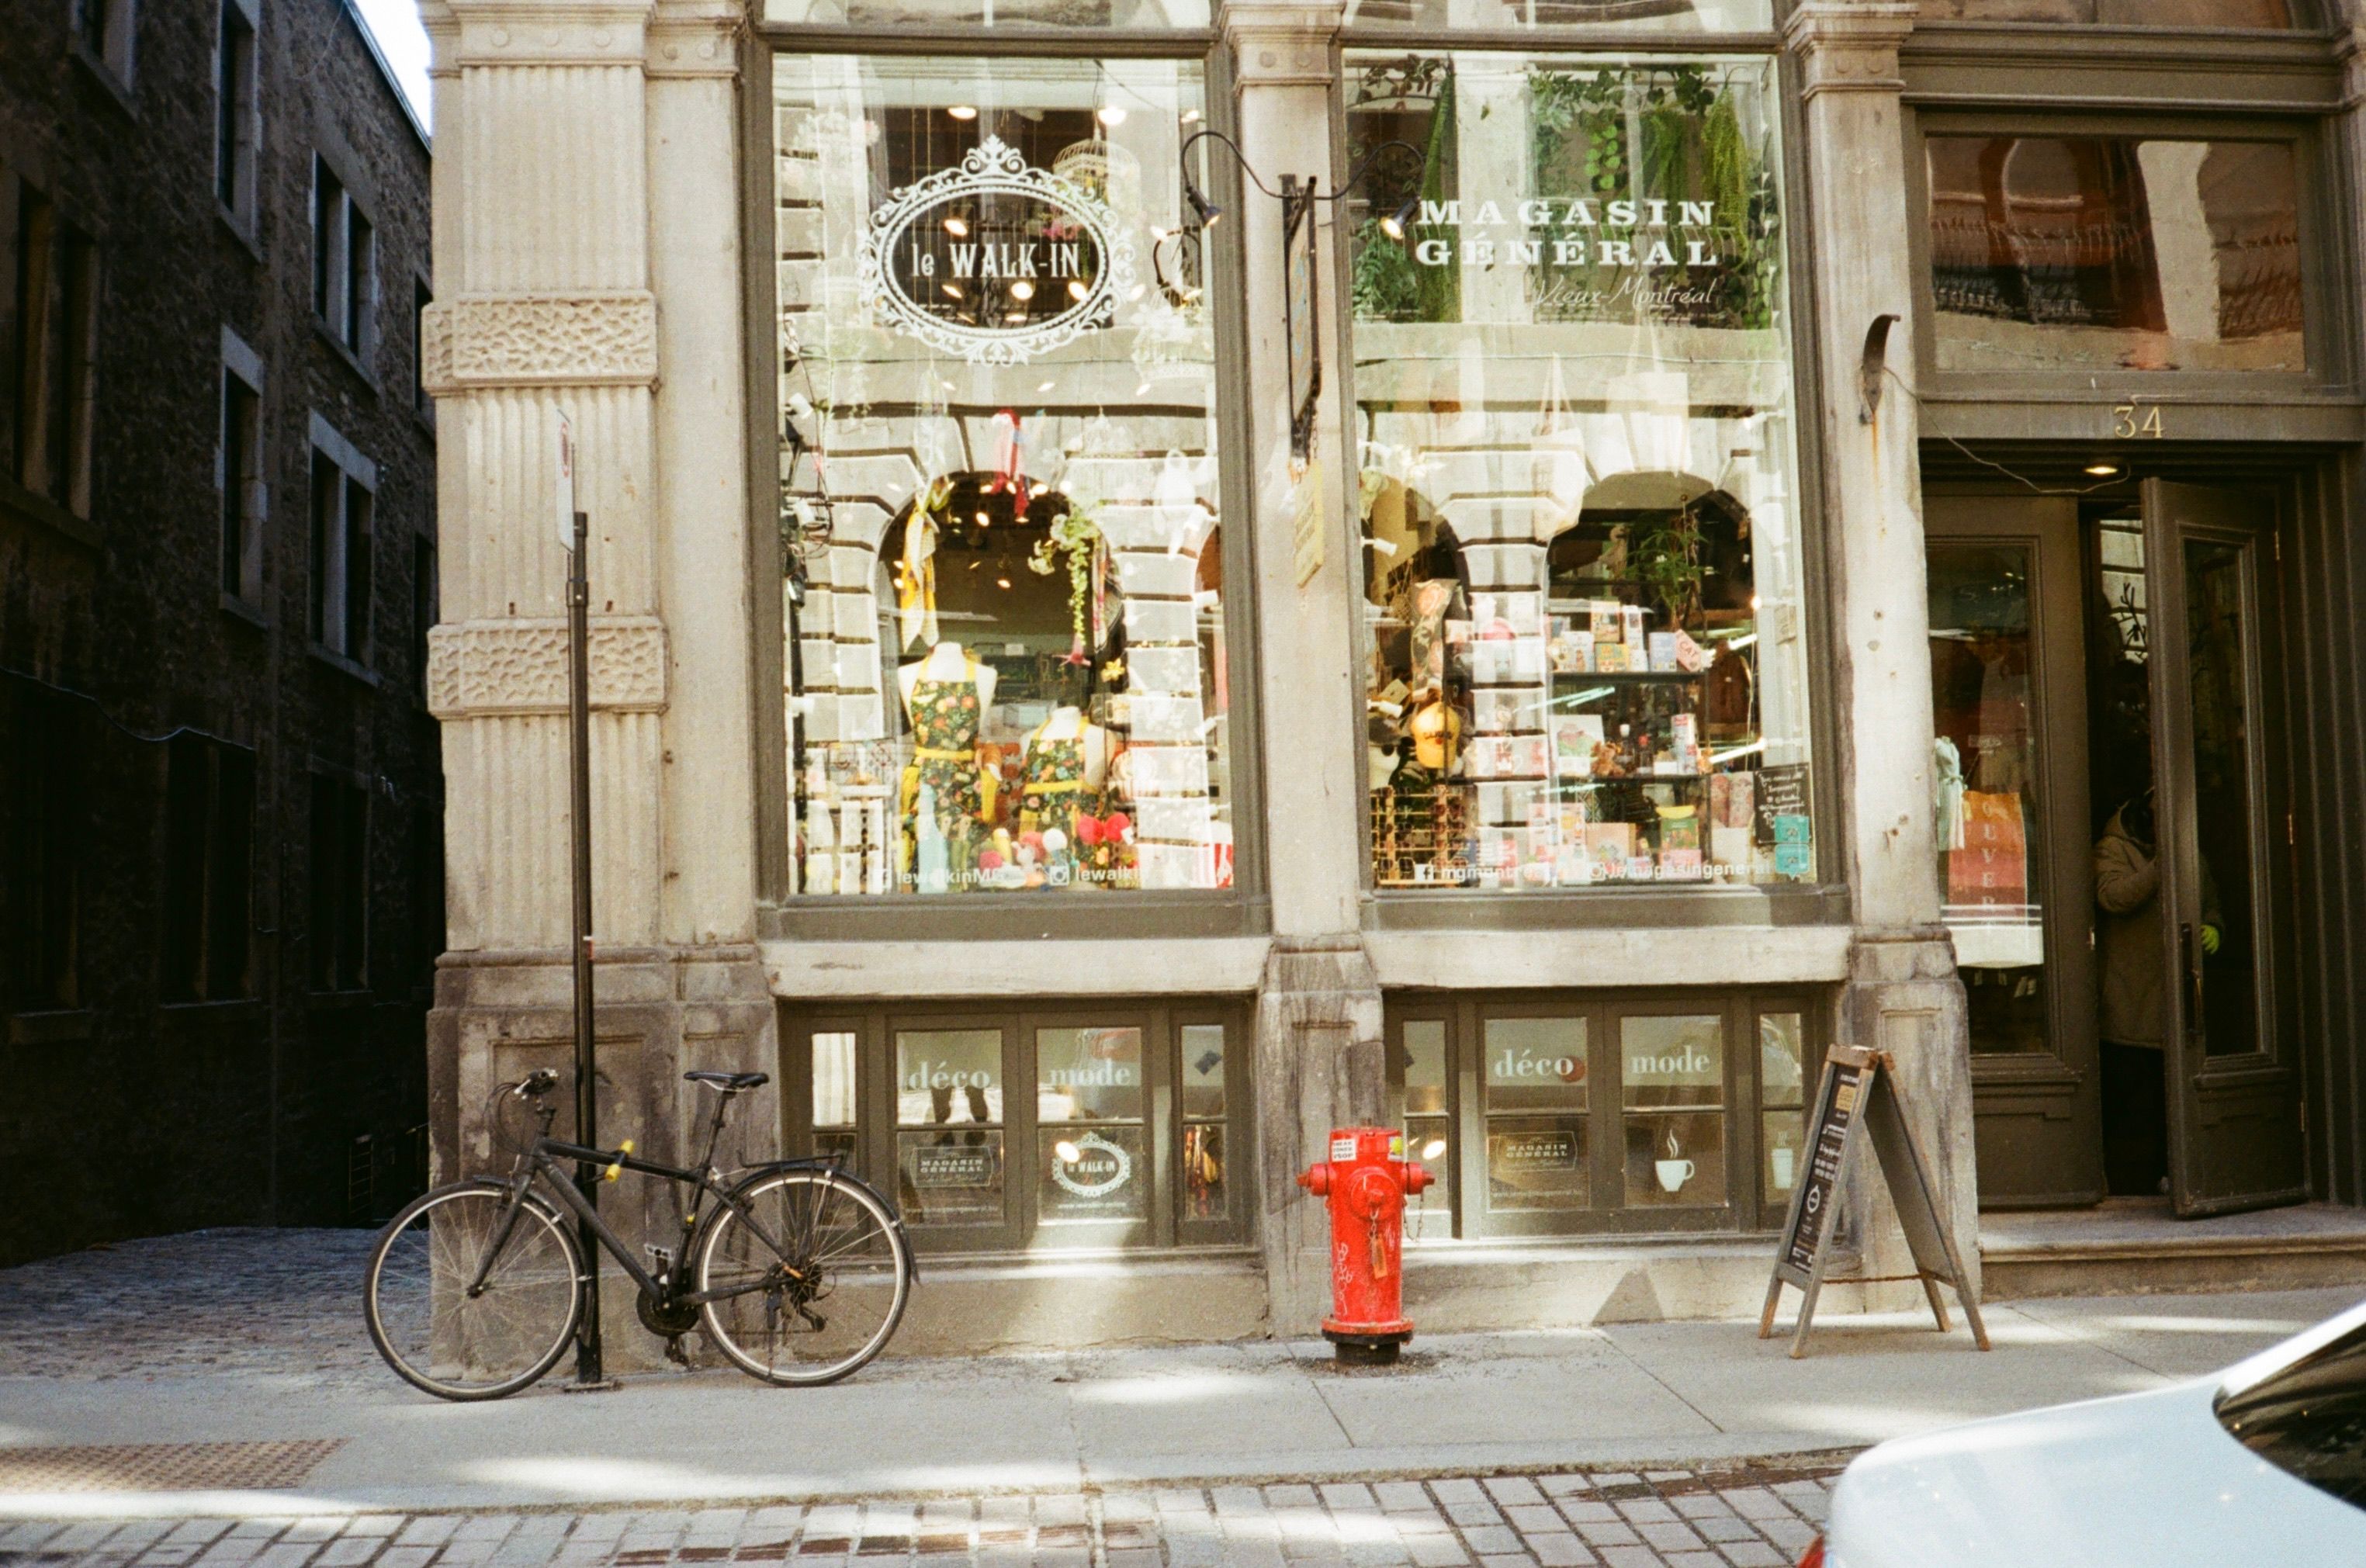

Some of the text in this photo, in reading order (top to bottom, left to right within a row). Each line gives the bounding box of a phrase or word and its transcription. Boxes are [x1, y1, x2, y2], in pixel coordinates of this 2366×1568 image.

[1417, 200, 1714, 226] MAGASIN
[912, 243, 1081, 279] le WALK-IN
[1415, 231, 1717, 265] GÉNÉRAL
[1535, 274, 1717, 309] Vieux-Montréal
[2114, 406, 2164, 438] 34
[1048, 1057, 1131, 1086] mode
[1494, 1048, 1574, 1078] déco
[1630, 1044, 1710, 1074] mode
[909, 1061, 990, 1090] déco
